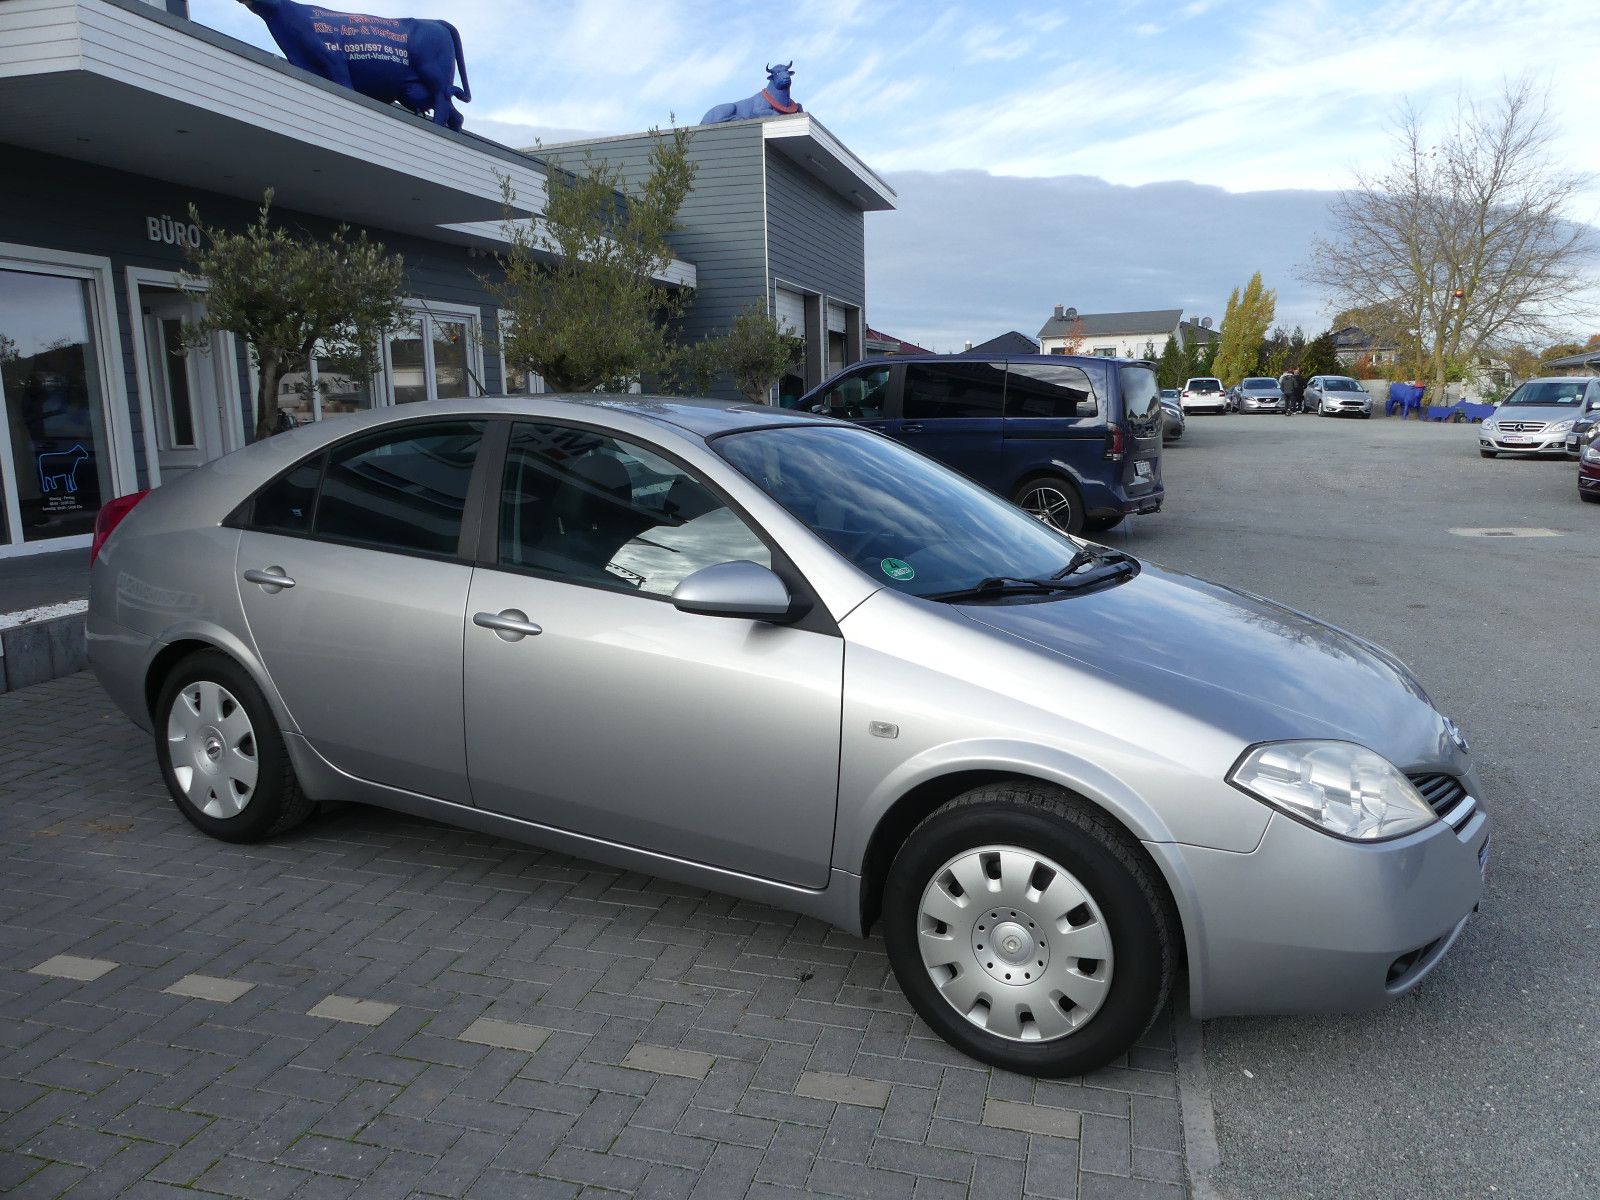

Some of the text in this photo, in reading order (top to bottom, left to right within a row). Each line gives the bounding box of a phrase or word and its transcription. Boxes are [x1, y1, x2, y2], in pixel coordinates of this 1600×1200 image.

[325, 42, 342, 52] Tel.
[344, 43, 382, 53] 0391/597
[395, 48, 408, 58] 100
[349, 52, 402, 64] Albert-Vater-Str.
[146, 214, 201, 249] BÜRO
